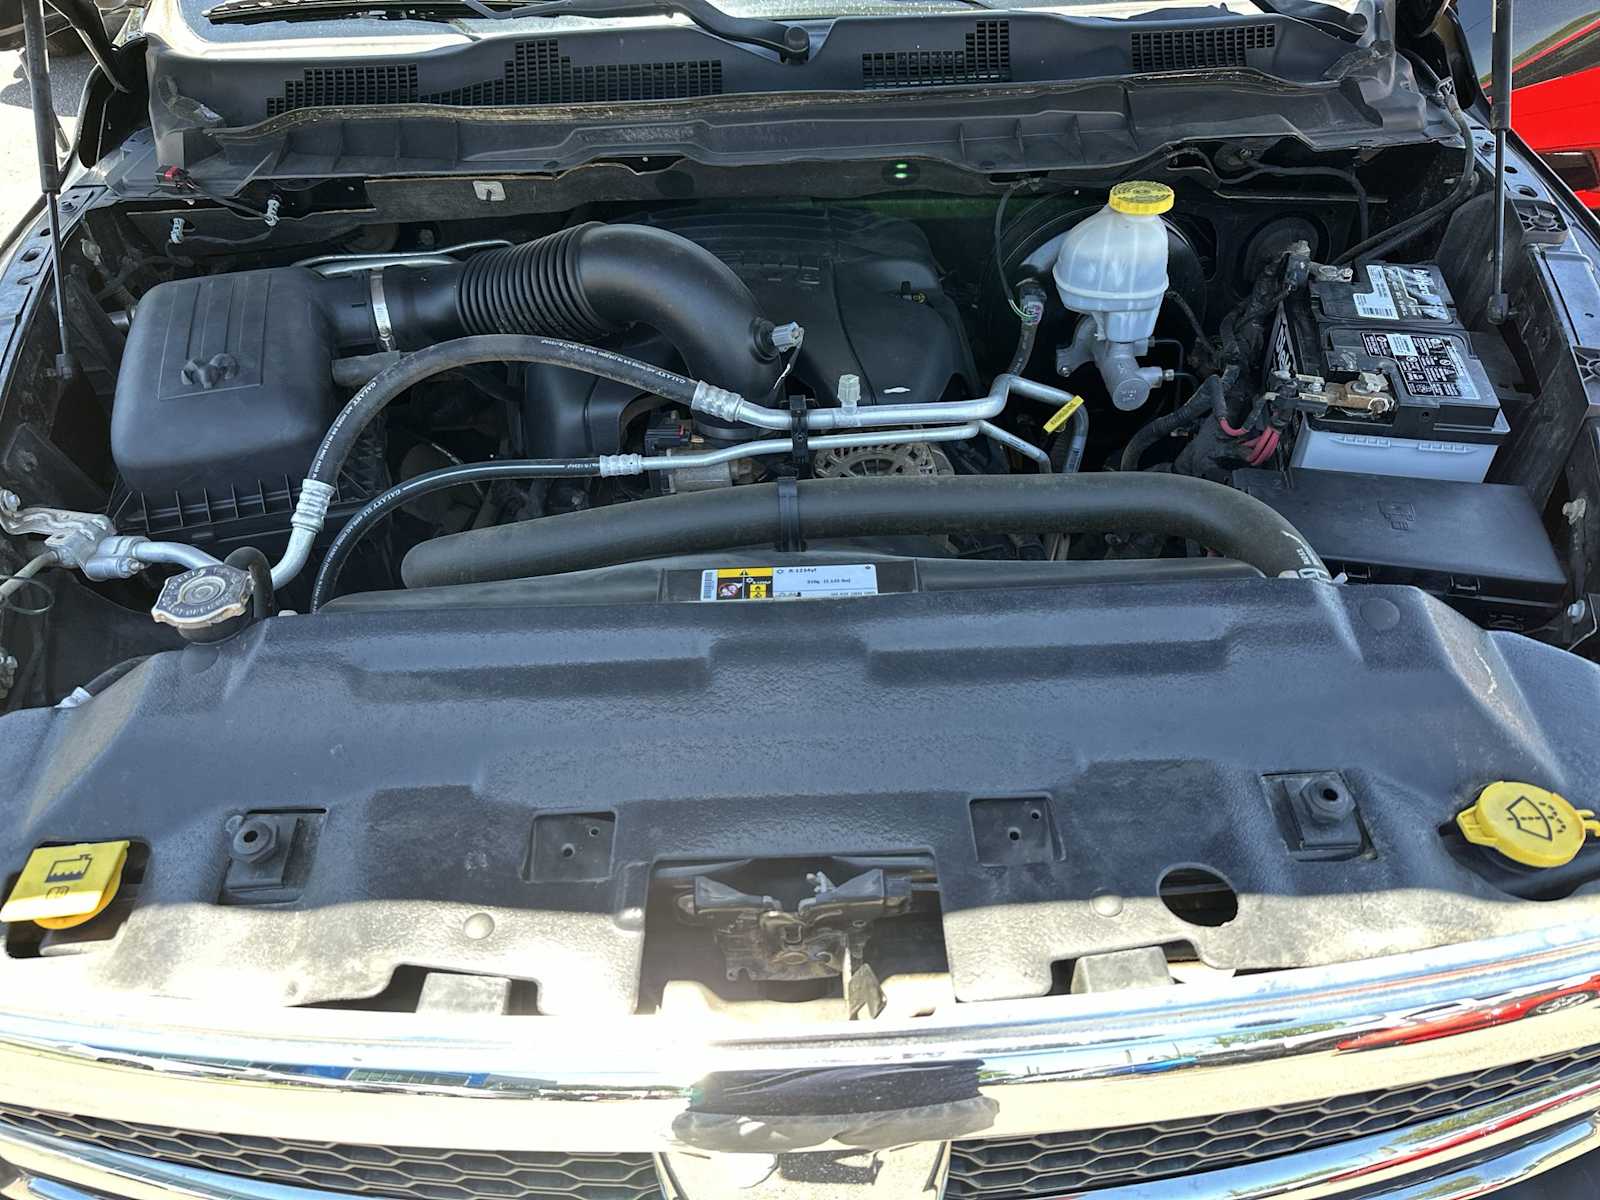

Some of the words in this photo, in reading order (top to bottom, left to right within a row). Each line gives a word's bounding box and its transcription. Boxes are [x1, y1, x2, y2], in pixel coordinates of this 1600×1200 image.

[655, 368, 686, 384] GALAXY
[353, 381, 377, 407] GALAXY
[373, 488, 402, 511] GALAXY
